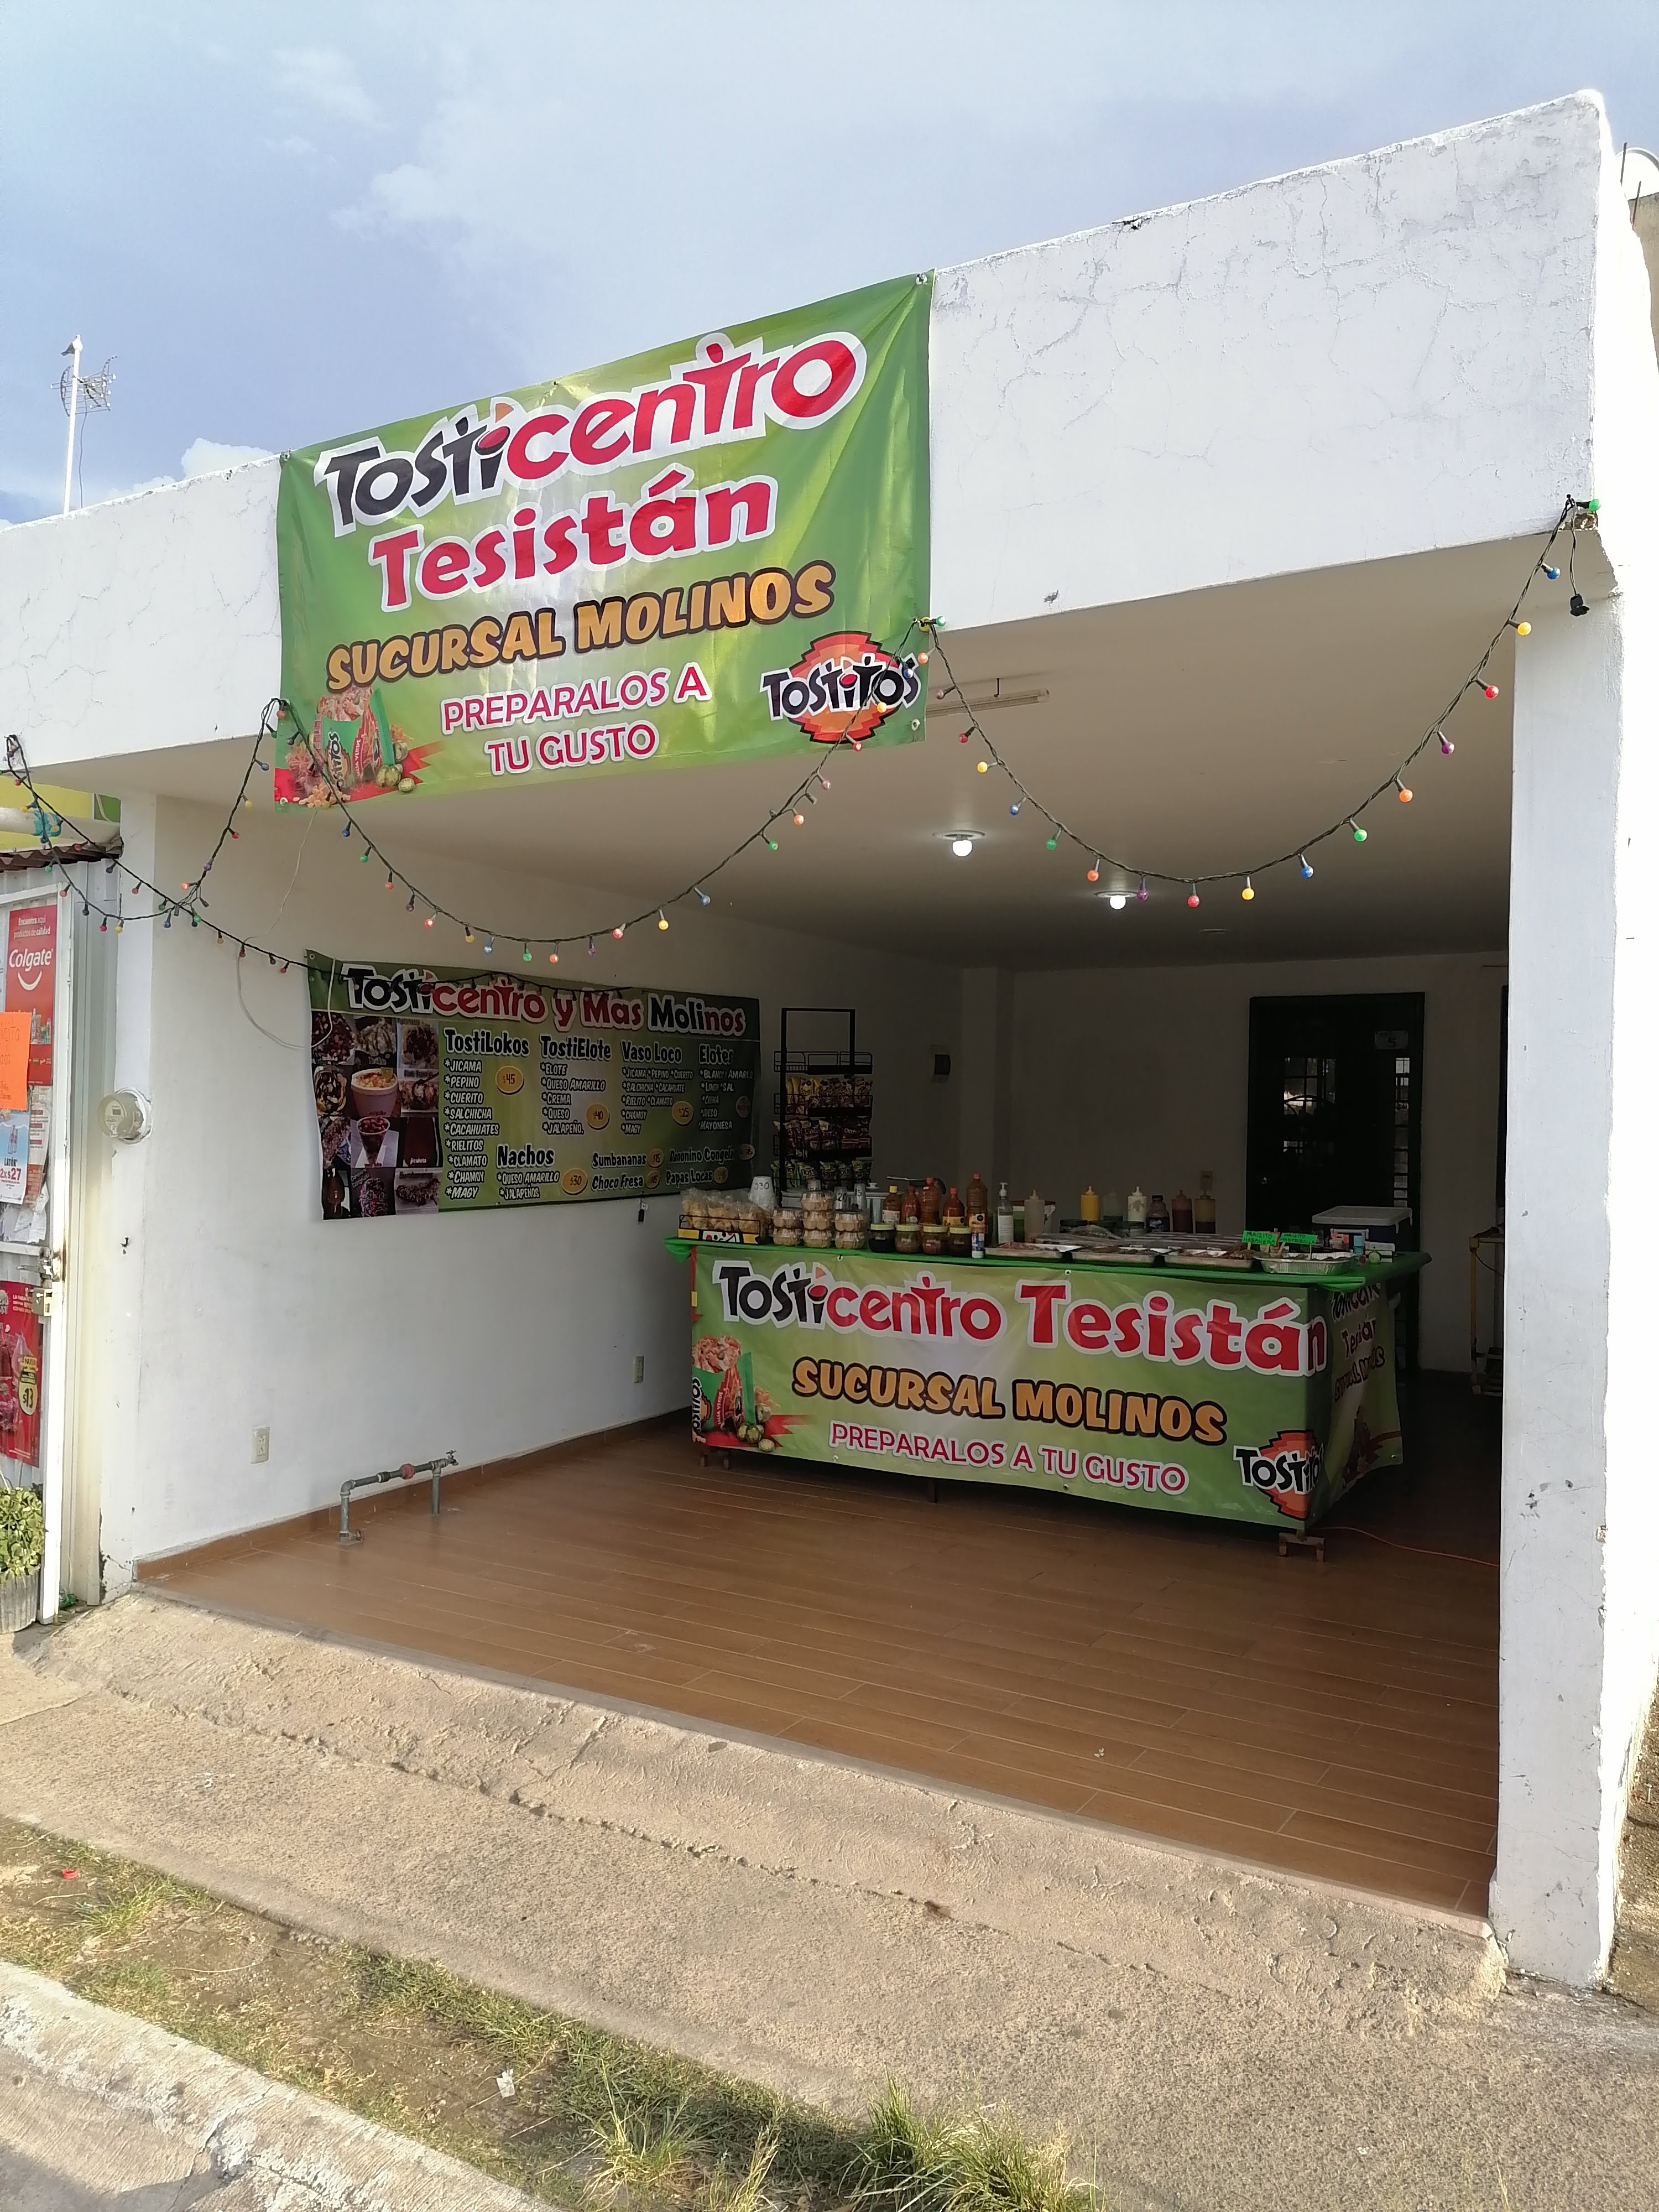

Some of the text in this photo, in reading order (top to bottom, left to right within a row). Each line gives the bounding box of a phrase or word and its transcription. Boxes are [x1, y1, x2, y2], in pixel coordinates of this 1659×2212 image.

[371, 470, 769, 607] Tesistán
[327, 560, 836, 694] SUCURSAL MOLINOS
[444, 665, 709, 730] PREPARALOS A
[487, 723, 656, 773] TU GUSTO
[9, 948, 53, 972] Colgate
[582, 992, 642, 1026] Mas
[650, 996, 744, 1033] Molinos
[445, 1028, 529, 1055] TostiLokos
[540, 1035, 611, 1060] TostiElote
[622, 1040, 682, 1064] Vaso Loco
[450, 1060, 483, 1073] JICAMA
[545, 1063, 568, 1076] ELOTE
[450, 1076, 480, 1089] PEPINO
[546, 1079, 607, 1091] QUESO AMARILLO
[450, 1092, 484, 1104] CUERITO
[547, 1093, 571, 1105] CREMA
[450, 1107, 493, 1120] SALCHICHA
[548, 1108, 570, 1120] QUESO
[450, 1123, 500, 1136] CACAHUATES
[451, 1139, 484, 1152] RIELITOS
[453, 1155, 488, 1168] CLAMATO
[497, 1144, 555, 1168] Nachos
[592, 1153, 647, 1168] Sumbananas
[454, 1170, 485, 1183] CHAMOY
[502, 1171, 560, 1185] QUESO AMARILLO
[592, 1174, 643, 1190] Choco Fresa
[666, 1169, 713, 1189] Papas Locas
[1019, 1285, 1324, 1372] Tesistán
[792, 1356, 1227, 1445] SUCURSAL MOLINOS
[832, 1423, 1187, 1492] PREPARALOS A TU GUSTO
